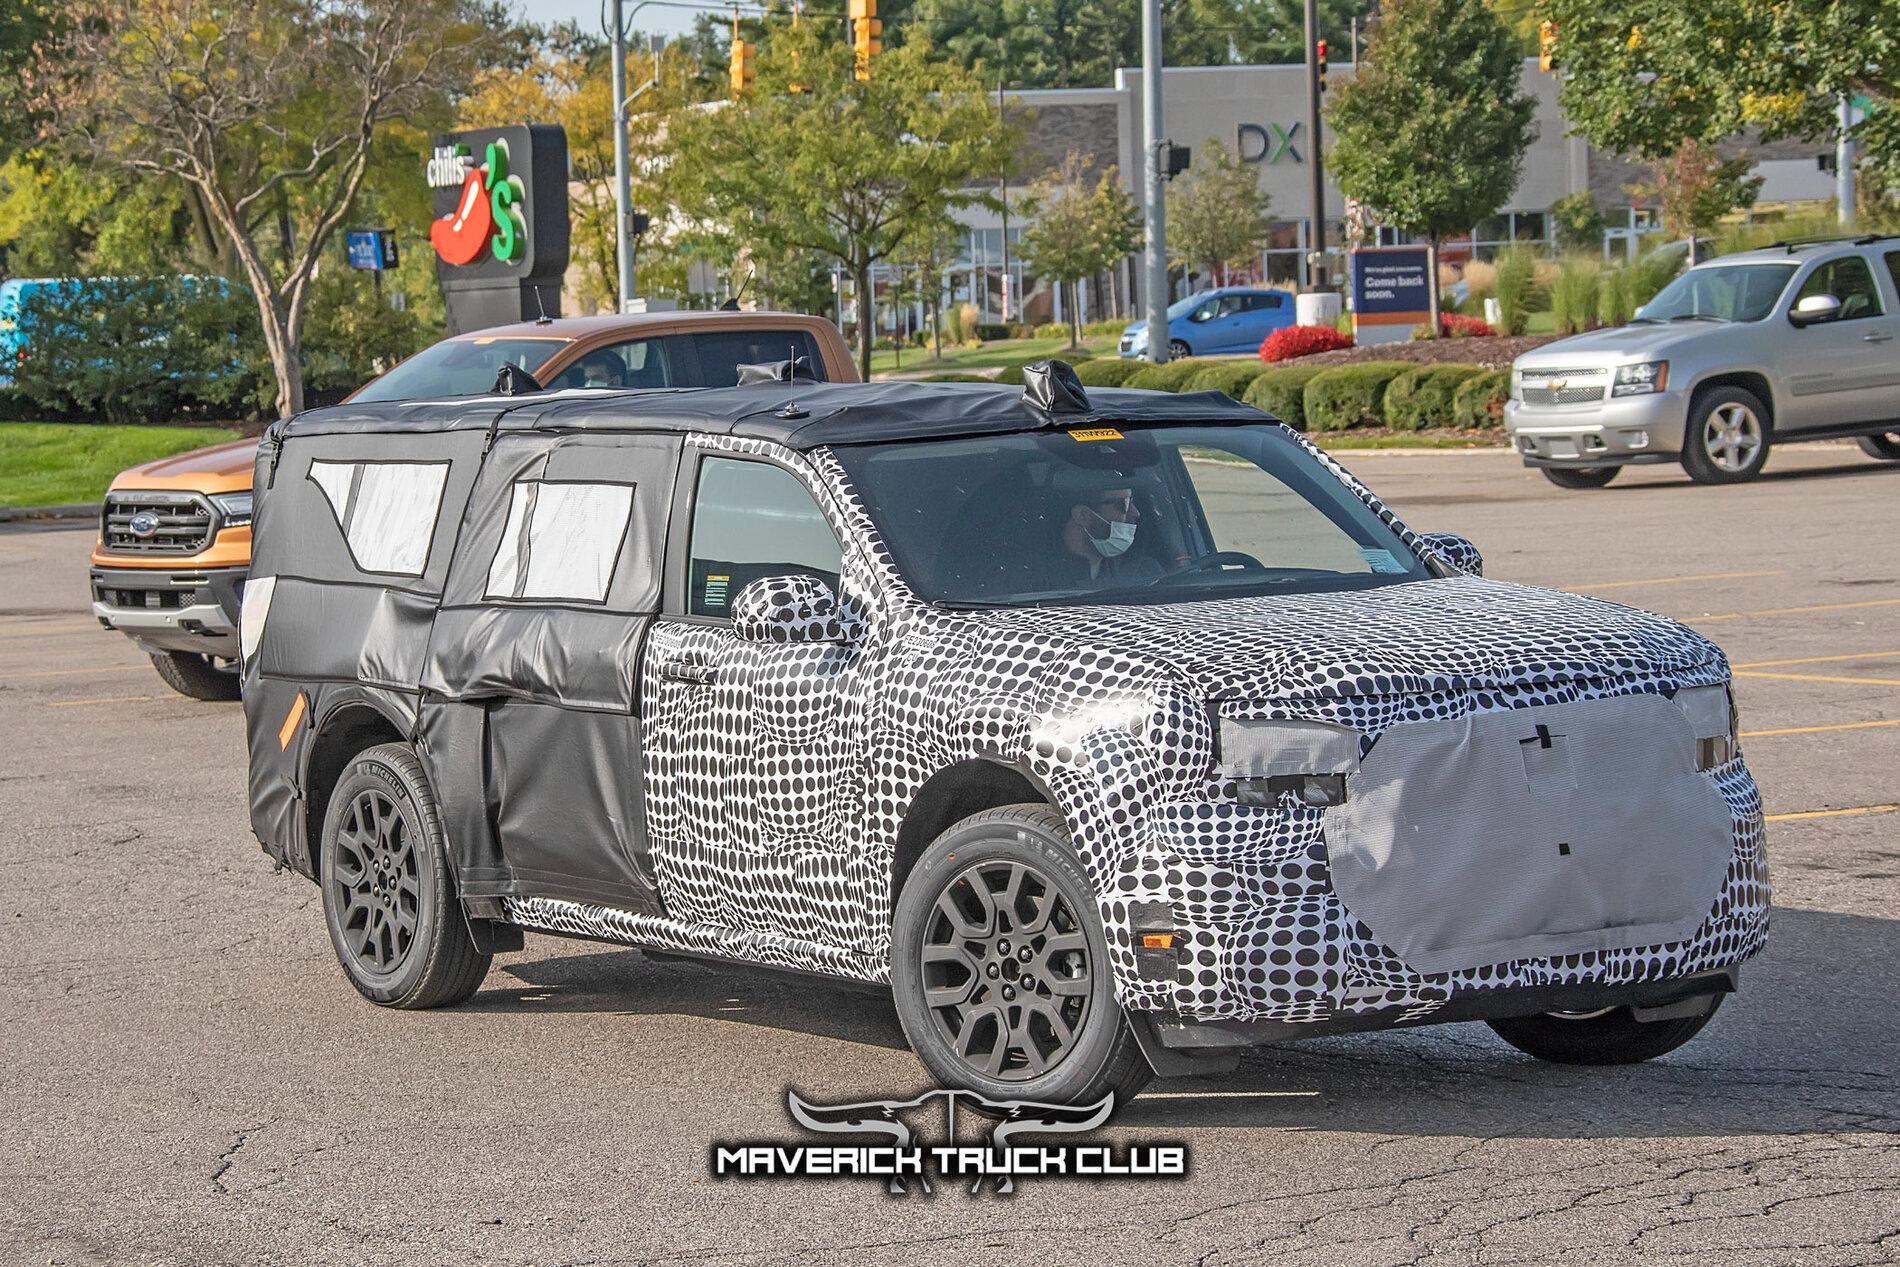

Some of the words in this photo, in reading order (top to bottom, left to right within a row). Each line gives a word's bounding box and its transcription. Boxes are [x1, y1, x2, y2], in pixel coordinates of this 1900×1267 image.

[1238, 121, 1304, 165] DX
[1365, 276, 1397, 288] Come
[1397, 274, 1425, 287] back
[371, 764, 405, 798] MICHELIN
